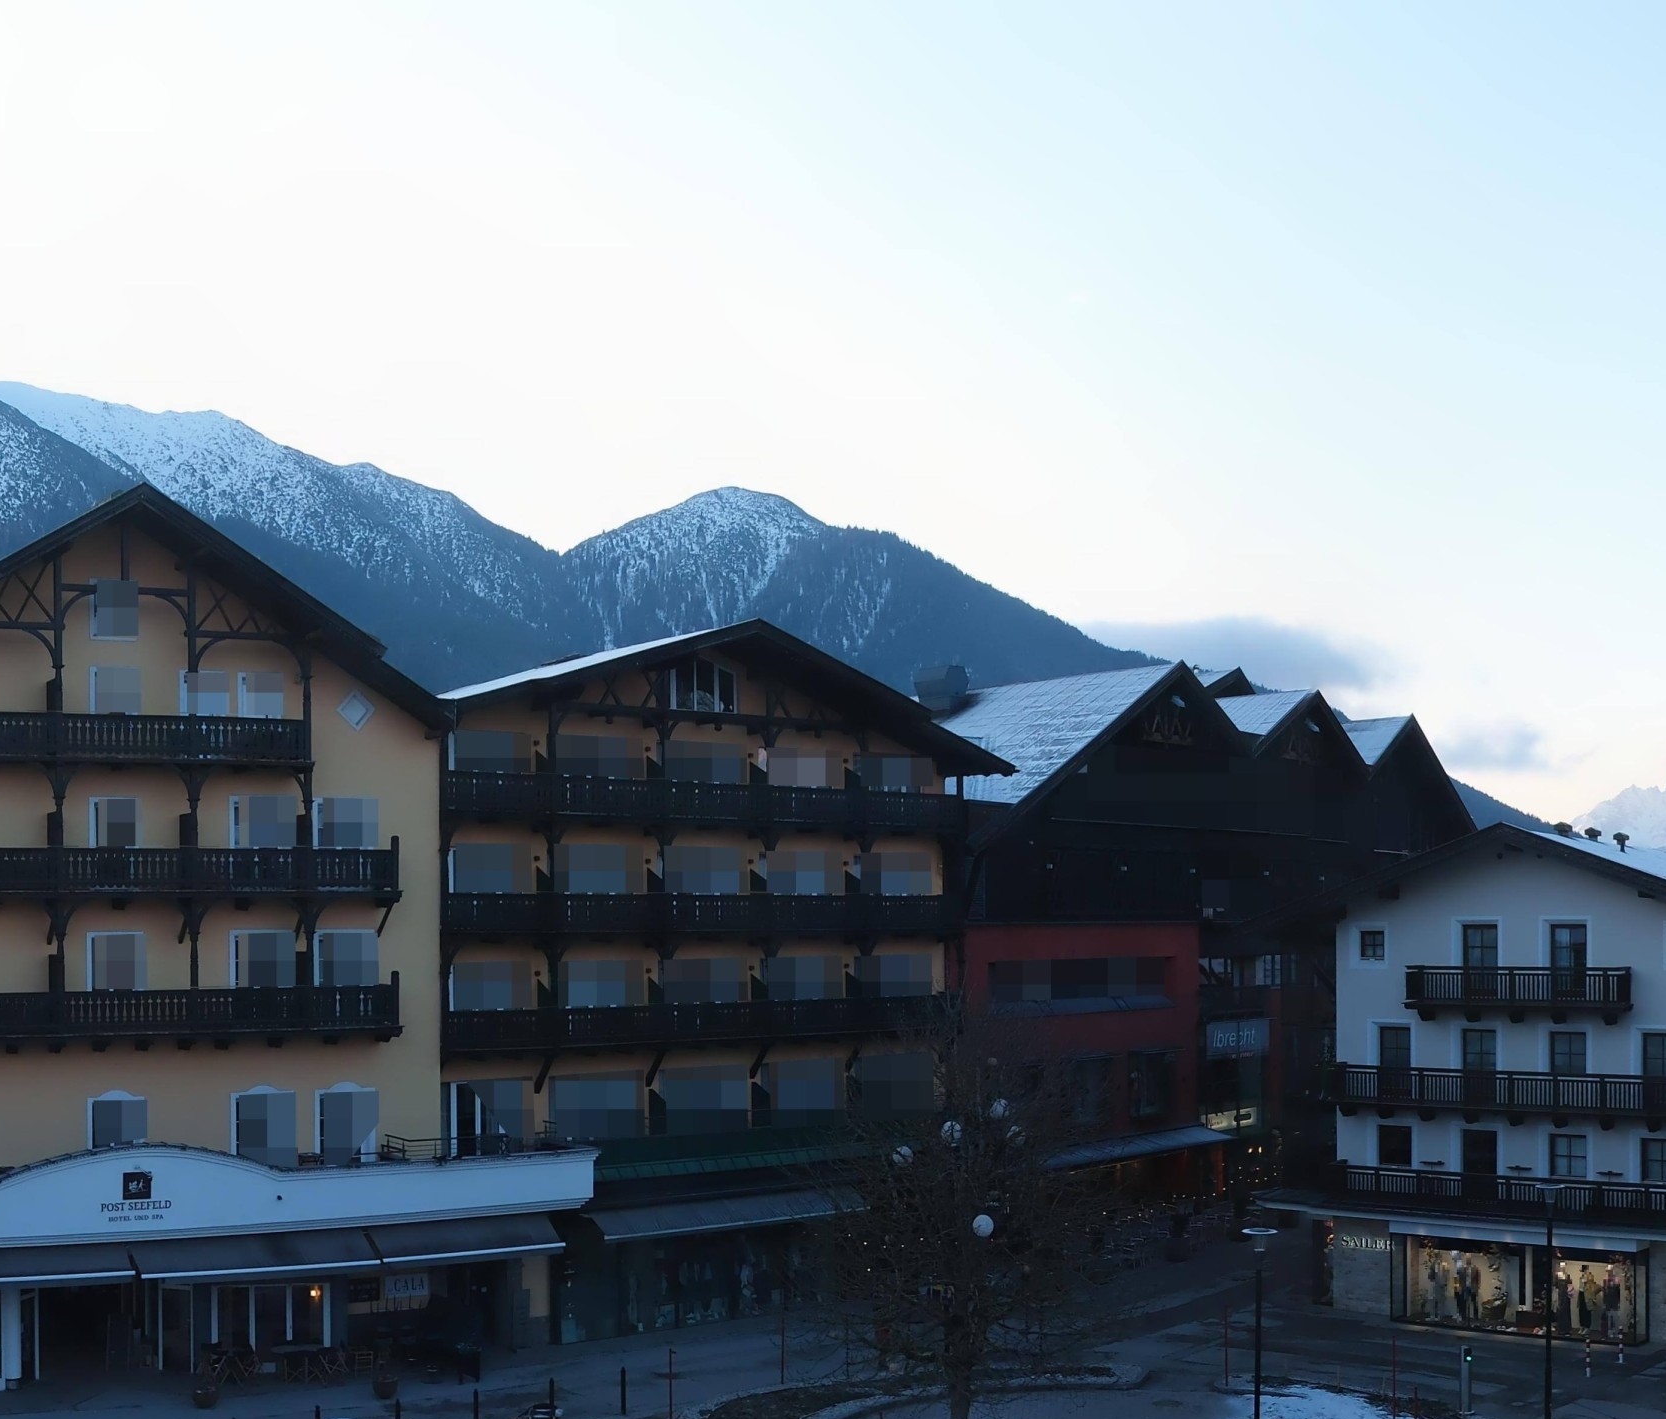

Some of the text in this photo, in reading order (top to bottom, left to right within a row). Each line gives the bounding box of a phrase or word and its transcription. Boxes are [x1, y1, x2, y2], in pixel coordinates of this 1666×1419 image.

[101, 1200, 172, 1212] POST SEEFELD
[1341, 1236, 1395, 1251] SAILER
